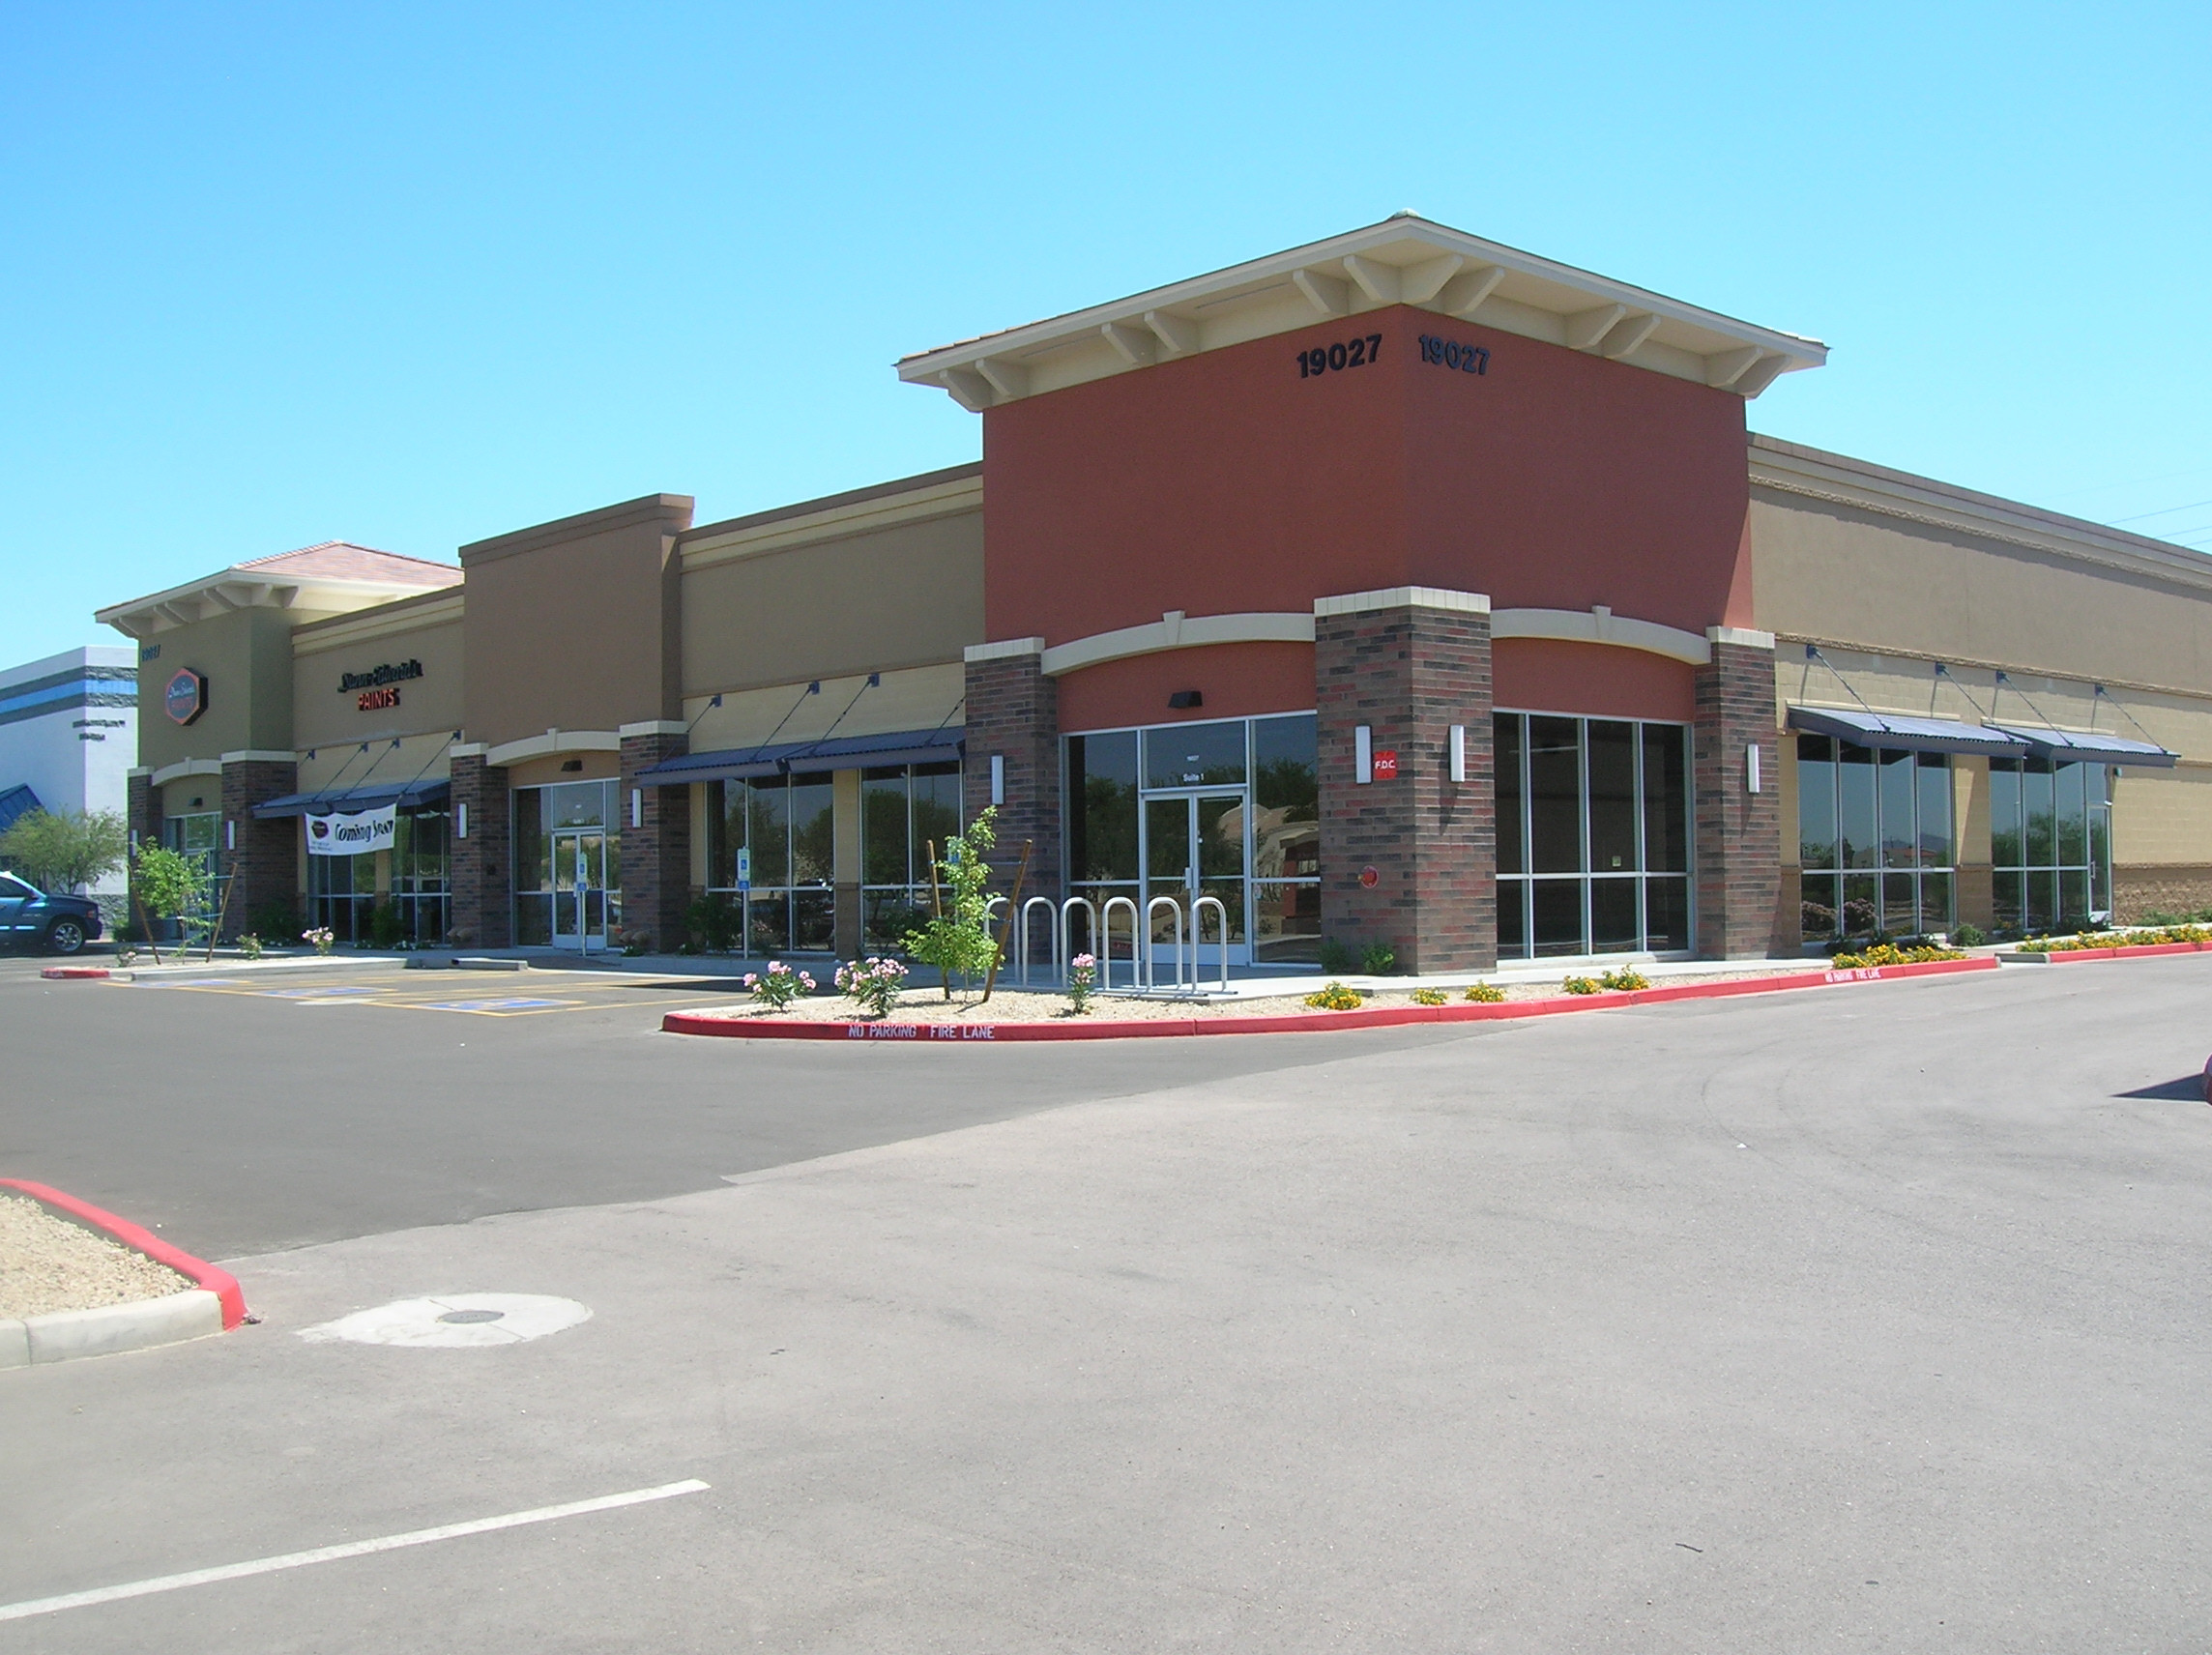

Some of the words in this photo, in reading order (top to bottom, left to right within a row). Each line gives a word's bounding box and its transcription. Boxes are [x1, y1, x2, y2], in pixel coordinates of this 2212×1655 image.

[1296, 334, 1382, 378] 19027
[1418, 334, 1491, 375] 19027
[358, 687, 400, 711] PAINTS
[335, 823, 371, 843] Coming
[848, 1025, 864, 1037] NO
[869, 1025, 917, 1038] PARKING
[930, 1025, 957, 1038] FIRE
[963, 1026, 996, 1039] LANE
